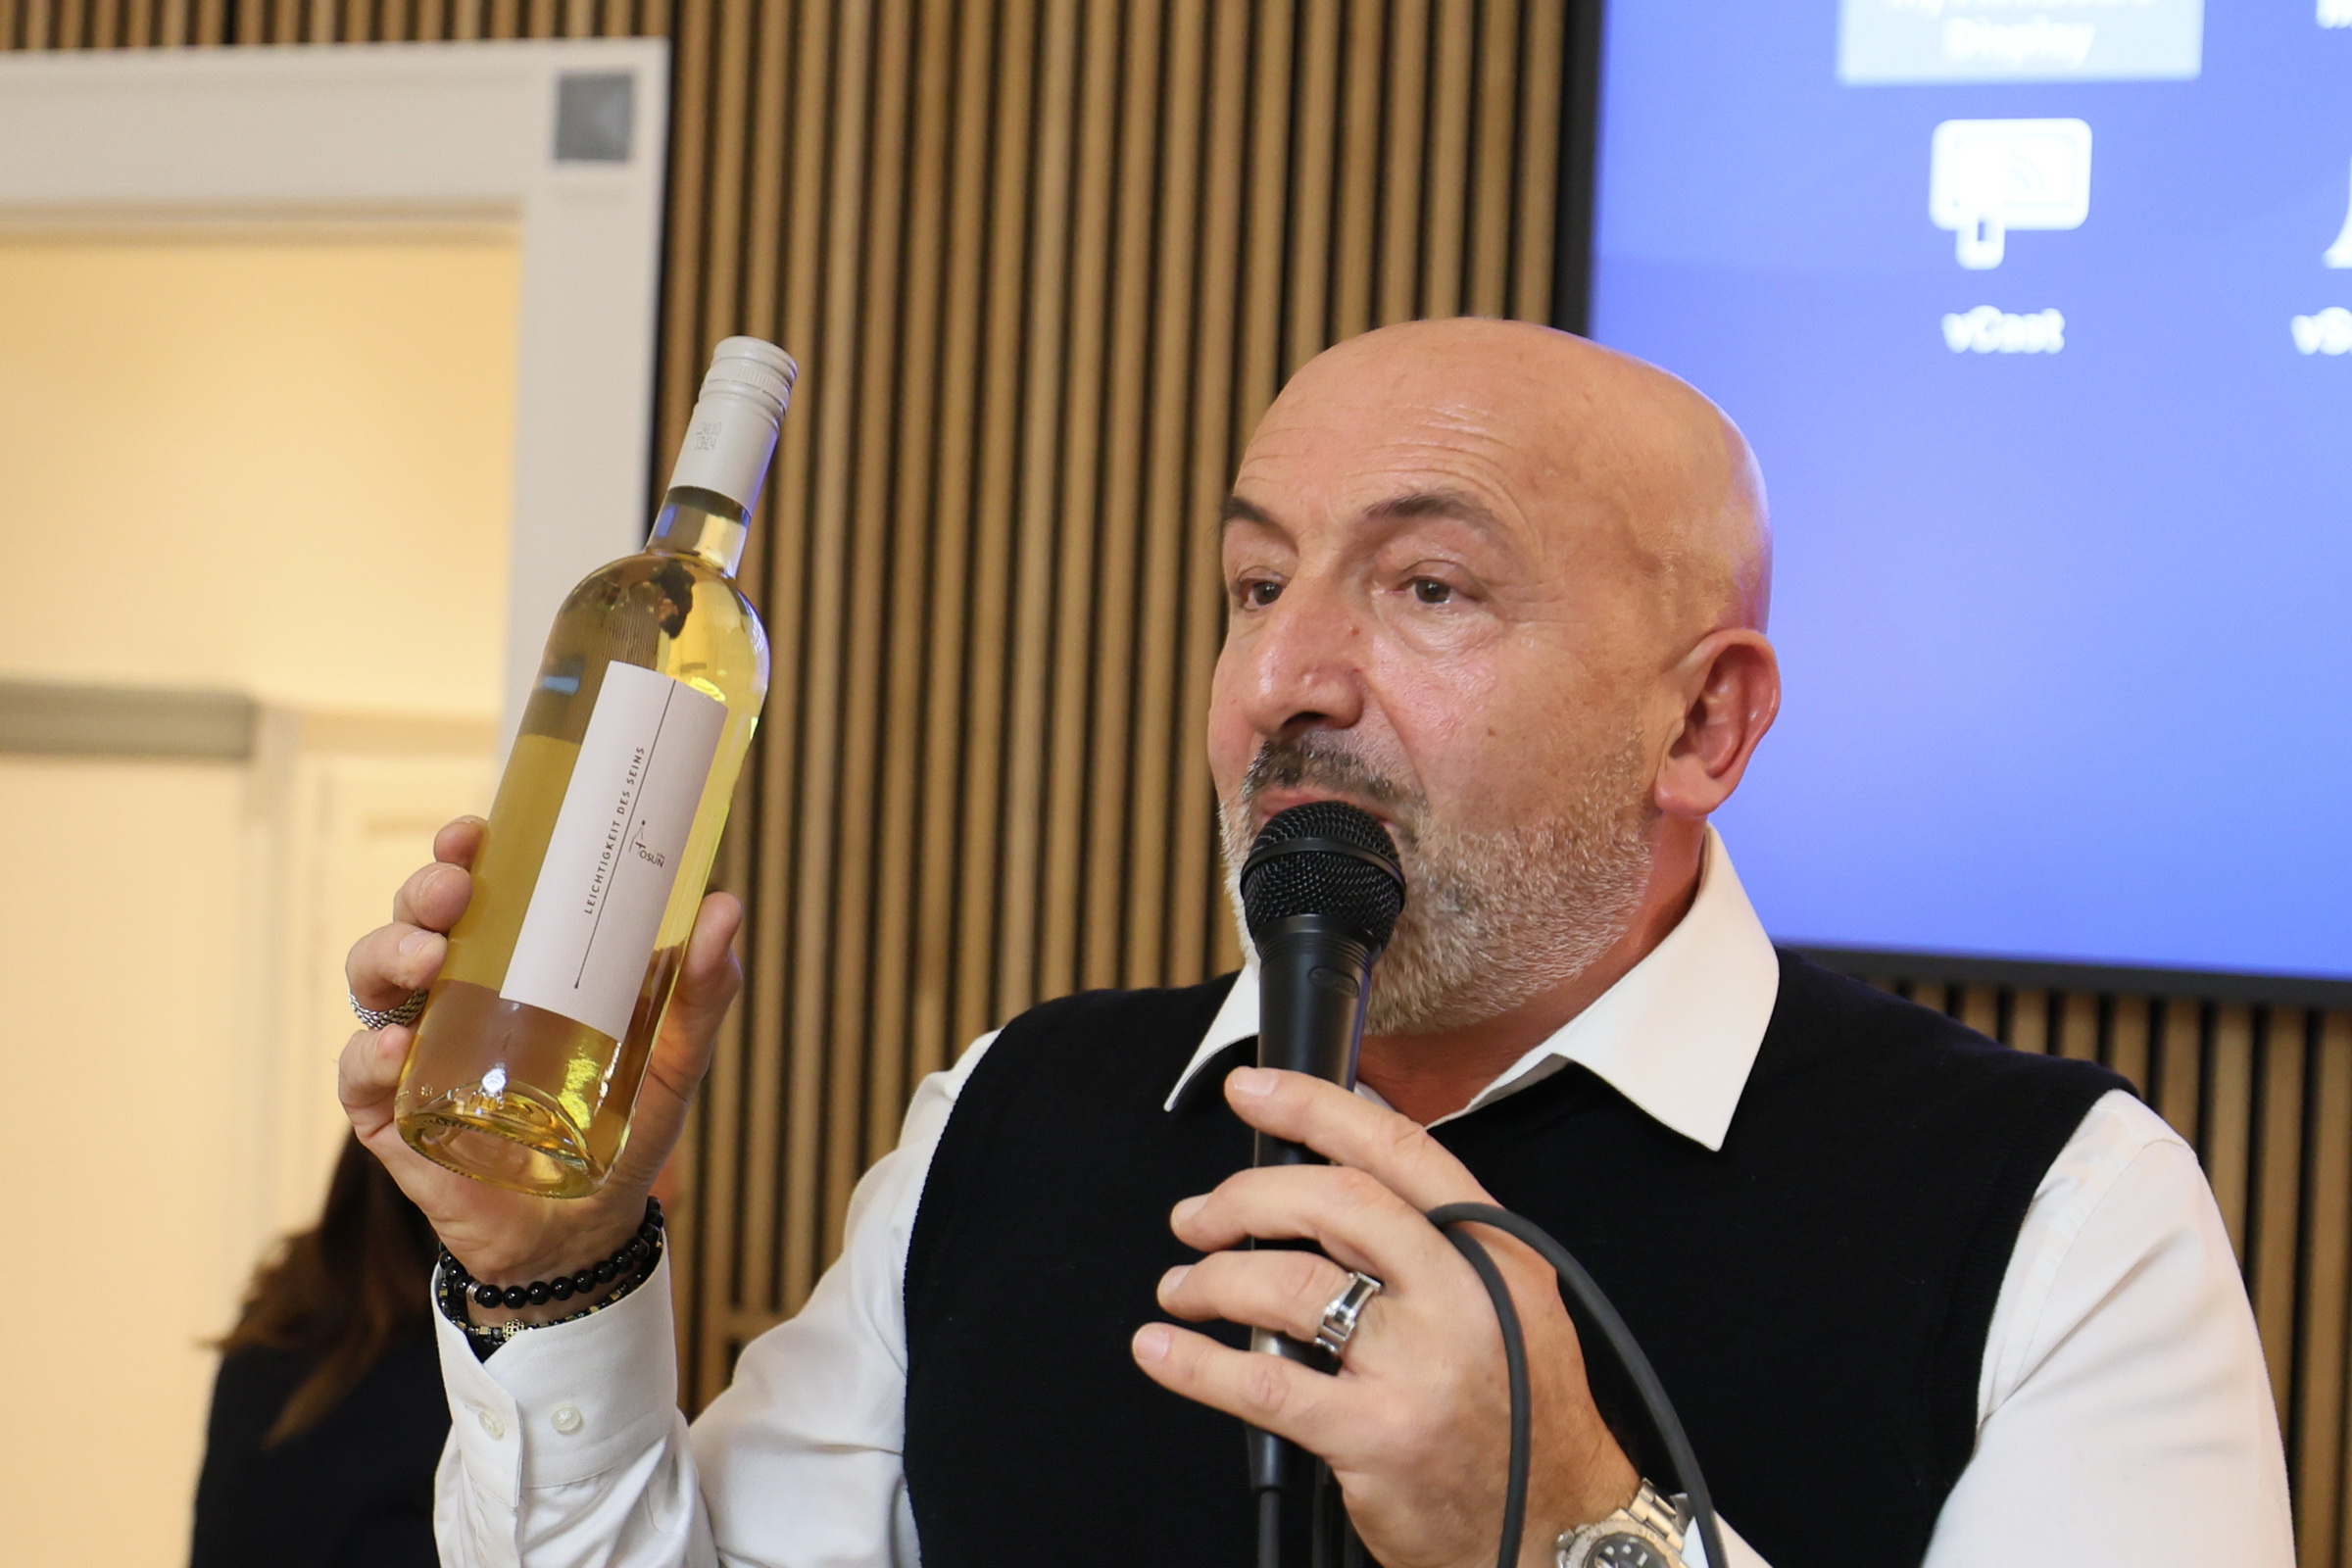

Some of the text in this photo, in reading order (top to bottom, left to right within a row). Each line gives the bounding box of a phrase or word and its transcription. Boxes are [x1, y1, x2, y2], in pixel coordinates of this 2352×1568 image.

[1943, 306, 2065, 354] vCast
[584, 747, 645, 914] LEICHTIGKEIT DES SEINS
